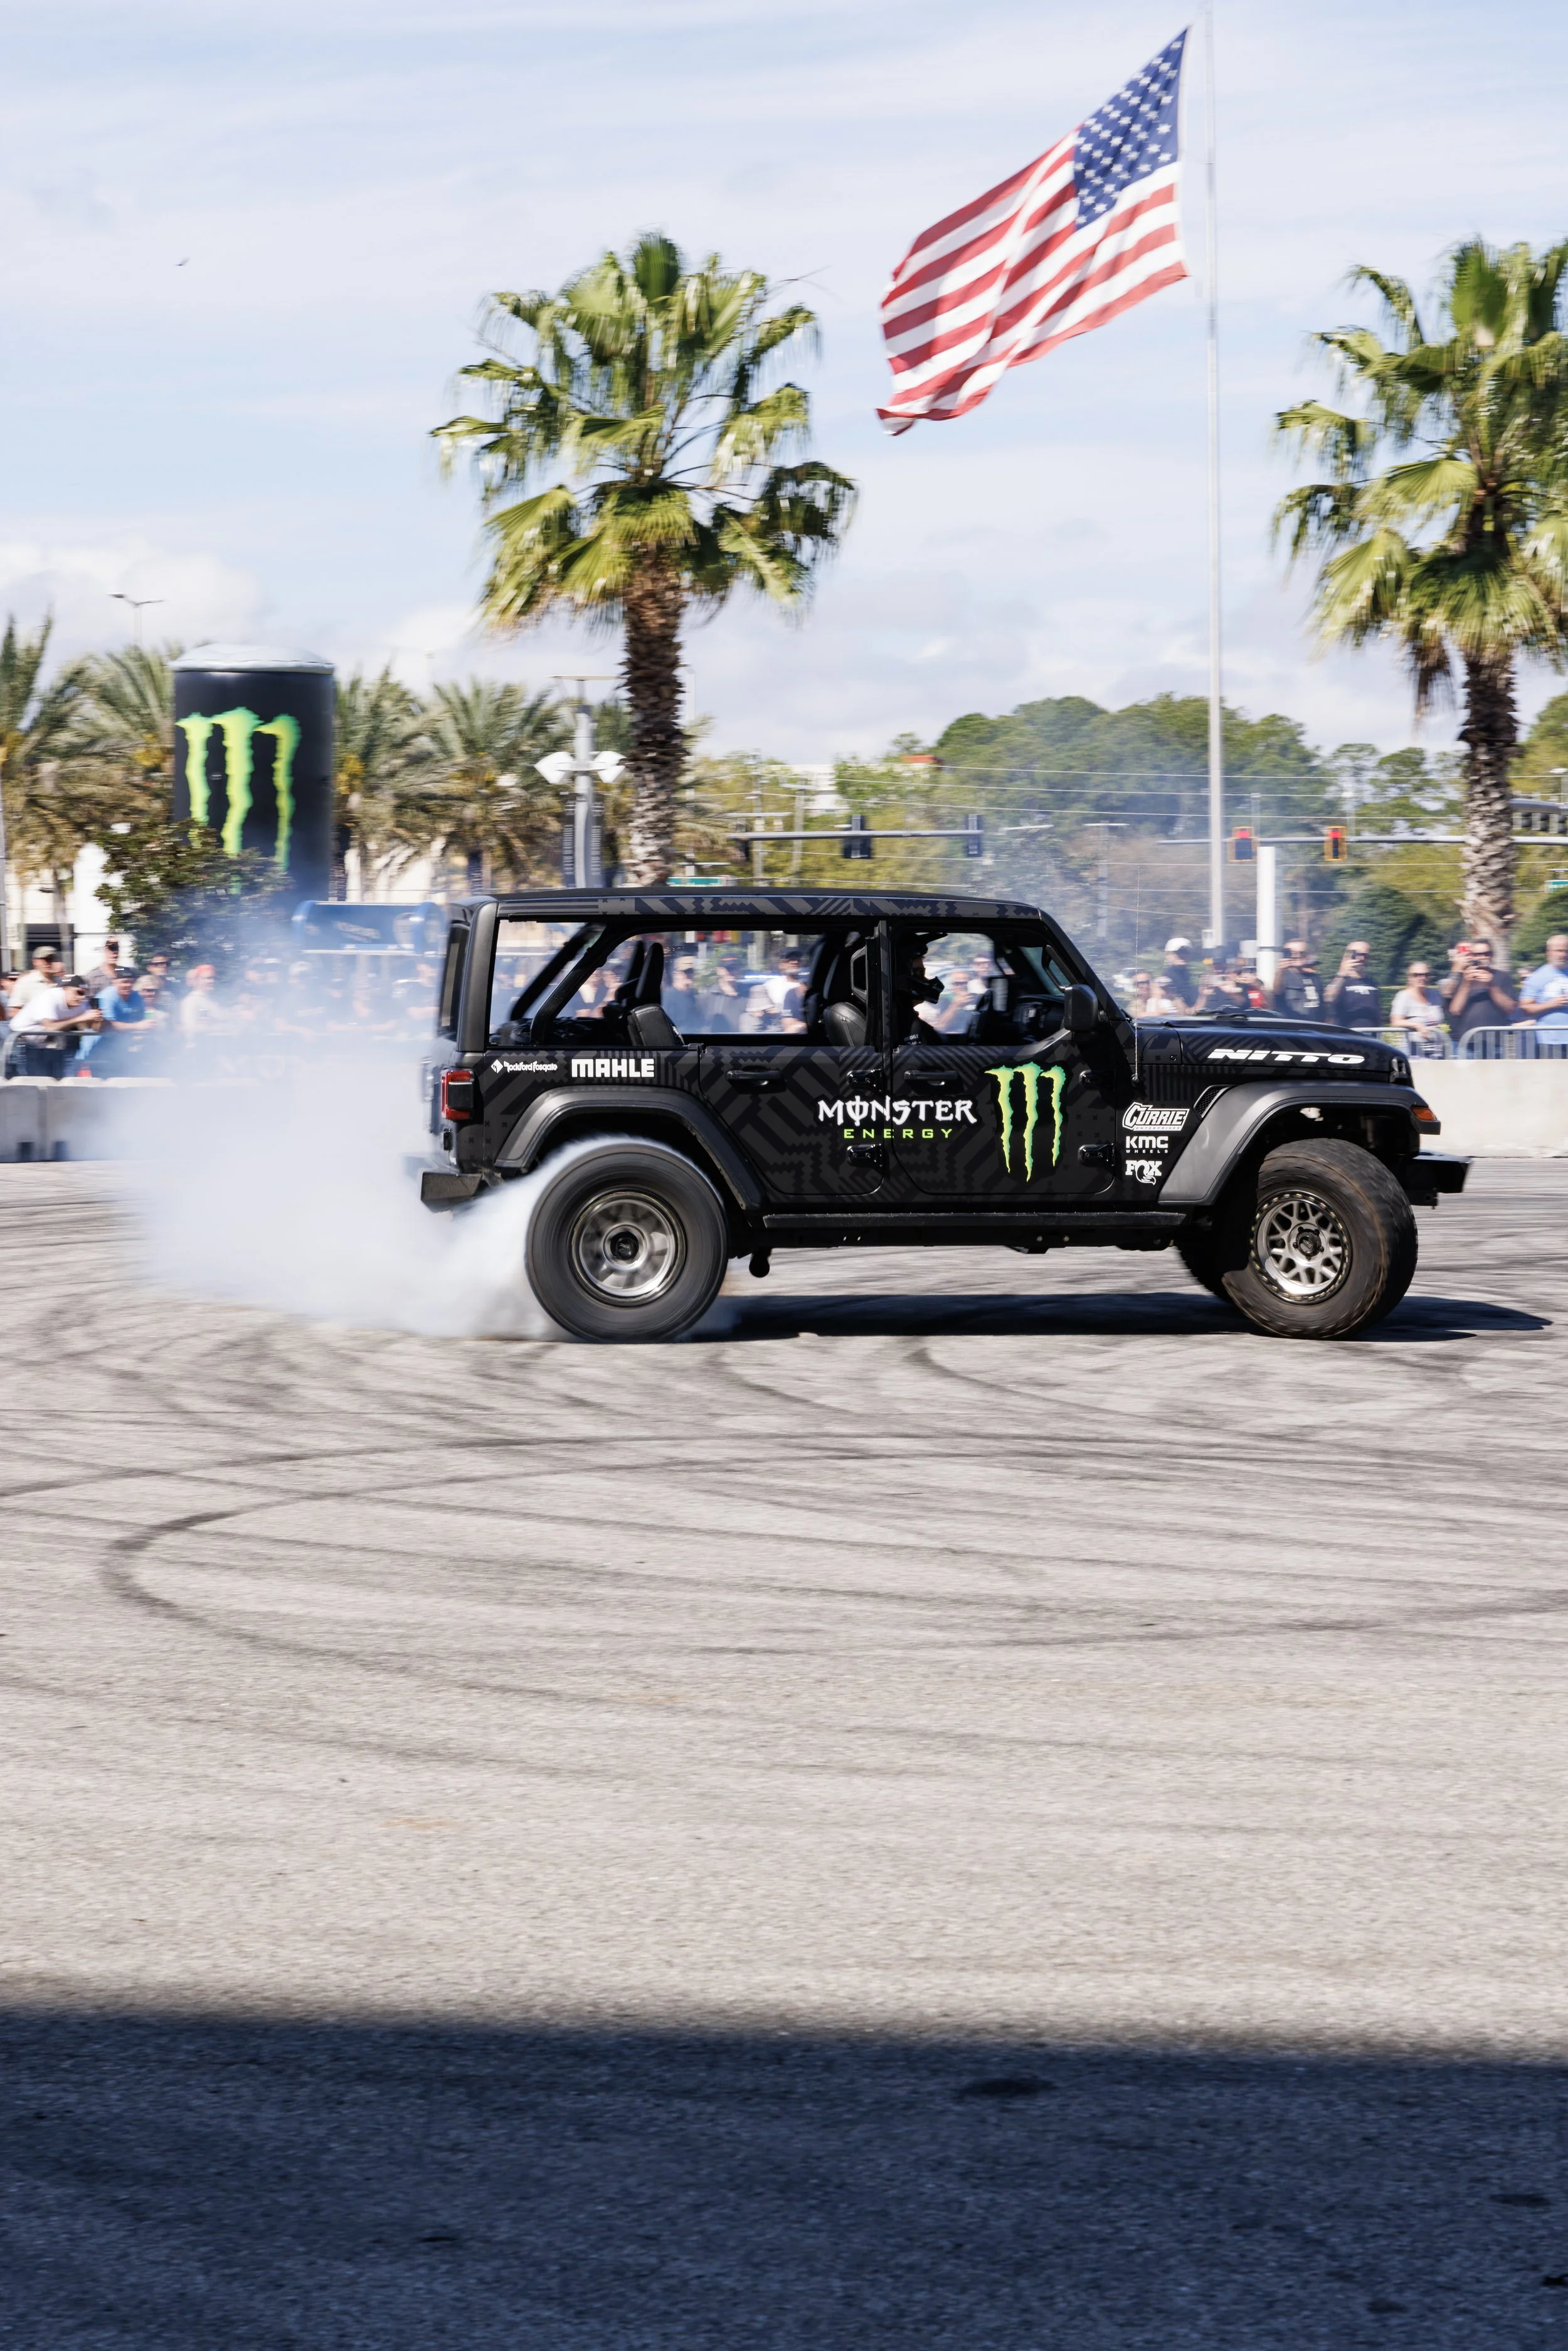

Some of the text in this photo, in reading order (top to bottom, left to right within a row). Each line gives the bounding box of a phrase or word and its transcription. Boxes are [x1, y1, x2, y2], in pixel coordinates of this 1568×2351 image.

[1207, 1048, 1365, 1064] NITTO
[571, 1058, 655, 1078] MAHLE
[817, 1095, 978, 1127] MONSTER
[1124, 1104, 1187, 1125] CURRIE
[844, 1128, 953, 1138] ENERGY
[1126, 1136, 1168, 1149] KMC
[1125, 1159, 1162, 1185] FOX
